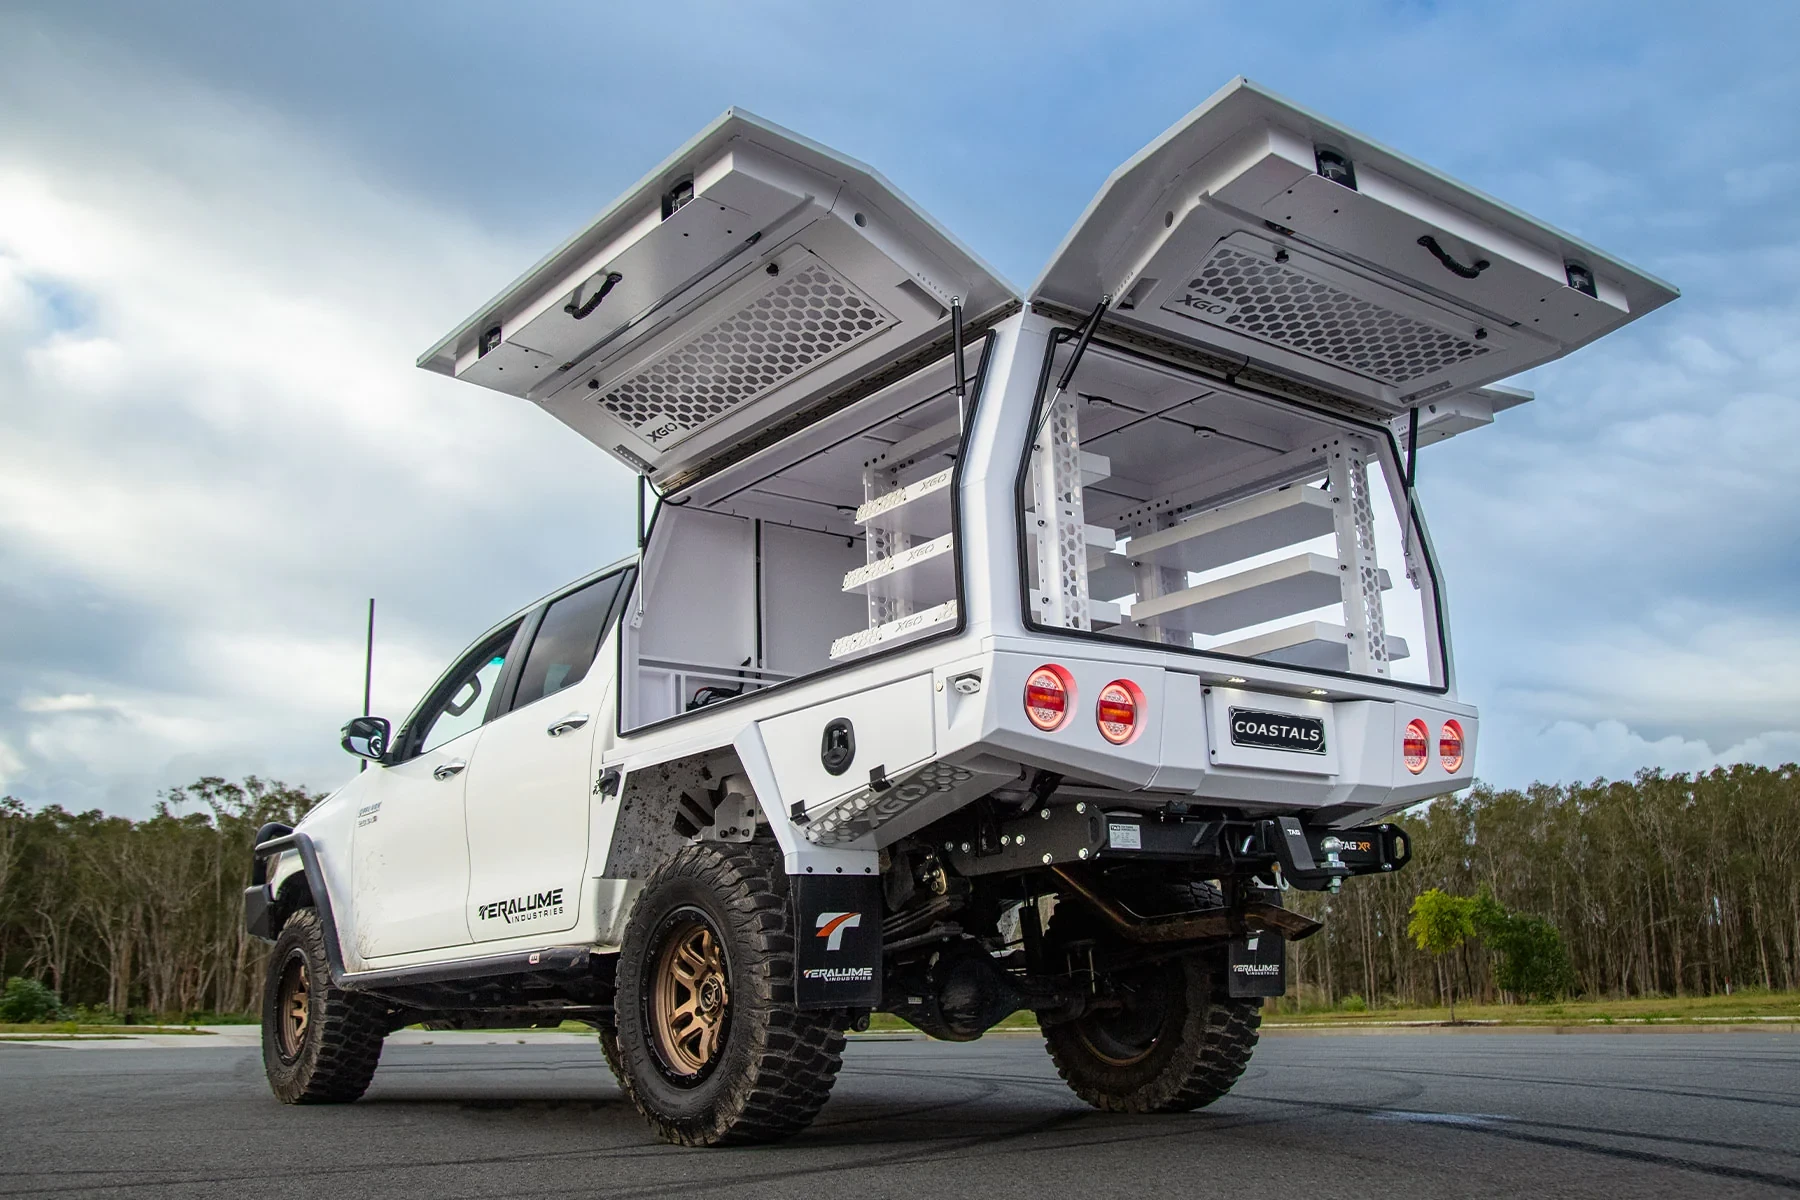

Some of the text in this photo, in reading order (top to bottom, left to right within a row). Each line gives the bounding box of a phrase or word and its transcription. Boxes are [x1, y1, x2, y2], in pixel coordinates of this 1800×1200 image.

[1175, 294, 1227, 315] XGO
[645, 422, 678, 443] XGO
[920, 473, 947, 492] XGO
[907, 543, 935, 562] XGO
[895, 615, 923, 633] XGO
[1235, 721, 1320, 742] COASTALS
[1357, 842, 1371, 853] XR
[478, 888, 563, 924] TERALUME
[511, 906, 564, 924] INDUSTRIES
[803, 967, 873, 982] TERALUME
